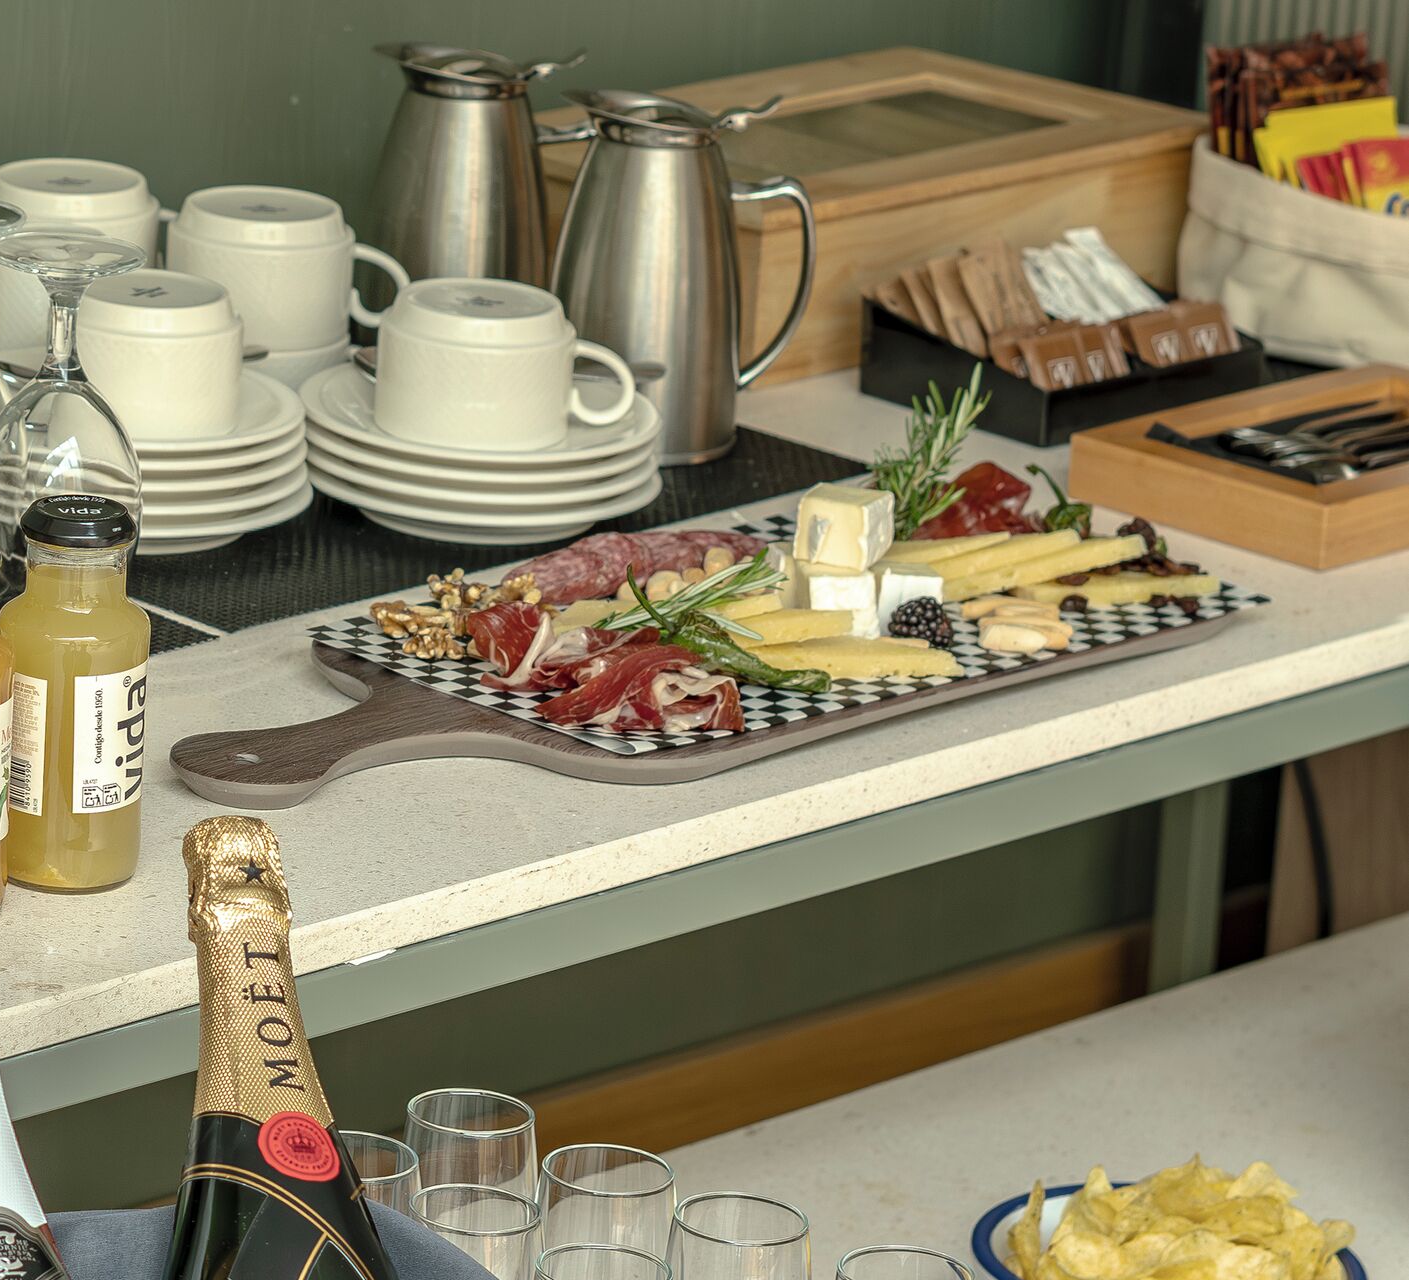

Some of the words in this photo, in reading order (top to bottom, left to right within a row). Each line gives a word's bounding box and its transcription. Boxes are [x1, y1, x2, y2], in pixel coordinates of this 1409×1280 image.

[94, 710, 103, 732] desde
[94, 732, 104, 764] Contigo
[242, 942, 304, 1092] MOËT
